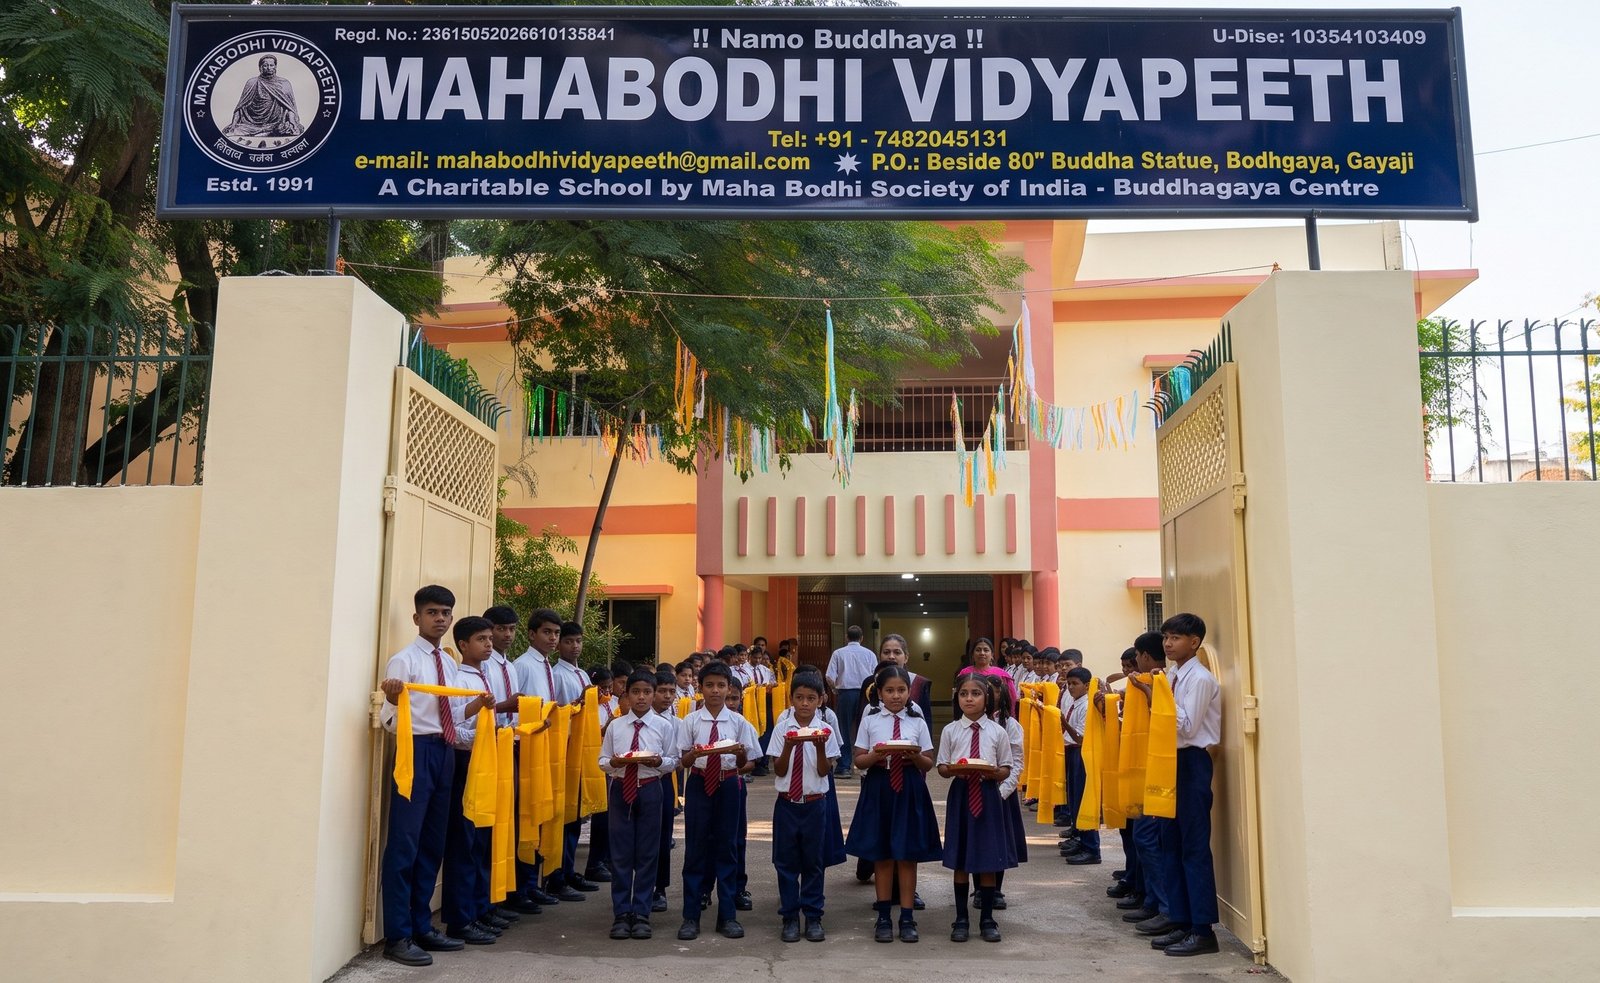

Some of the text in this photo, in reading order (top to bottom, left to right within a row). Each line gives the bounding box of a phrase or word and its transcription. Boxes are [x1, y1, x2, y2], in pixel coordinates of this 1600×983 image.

[335, 26, 615, 44] Regd. No.: 23615052026610135841
[693, 28, 983, 54] !! Namo Buddhaya !!
[1212, 28, 1427, 45] U-Dise: 10354103409
[193, 37, 337, 106] MAHABODHI VIDYAPEETH
[359, 55, 1404, 123] MAHABODHI VIDYAPEETH
[767, 130, 807, 148] Tel:
[814, 130, 852, 148] +91
[874, 129, 1007, 148] 7482045131
[354, 150, 810, 174] e-mail: mahabodhividyapeeth@gmail.com
[872, 152, 920, 171] P.O.:
[927, 152, 1002, 171] Beside
[1051, 151, 1134, 170] Buddha
[1141, 151, 1219, 173] Statue,
[1226, 151, 1340, 174] Bodhgaya,
[1346, 151, 1414, 174] Gayaji
[206, 177, 313, 192] Estd. 1991
[378, 178, 399, 196] A
[407, 178, 550, 196] Charitable
[558, 178, 652, 196] School
[661, 178, 693, 201] by
[702, 179, 776, 197] Maha
[785, 179, 862, 198] Bodhi
[870, 179, 975, 202] Society
[982, 179, 1011, 197] of
[1020, 178, 1087, 197] India
[1113, 178, 1281, 200] Buddhagaya
[1289, 178, 1380, 197] Centre
